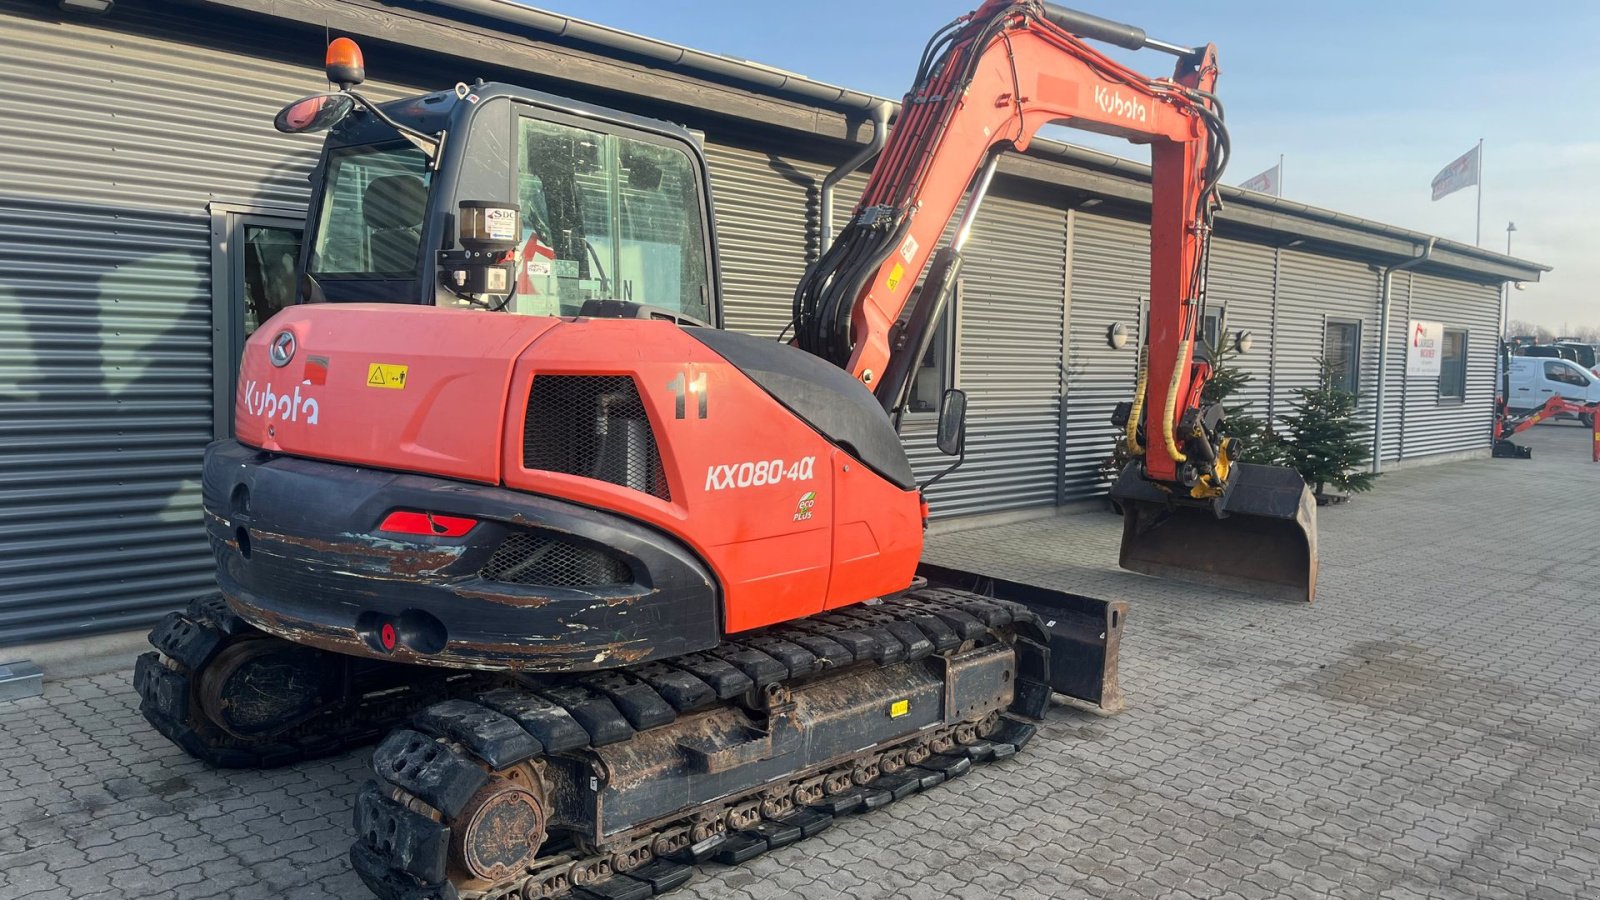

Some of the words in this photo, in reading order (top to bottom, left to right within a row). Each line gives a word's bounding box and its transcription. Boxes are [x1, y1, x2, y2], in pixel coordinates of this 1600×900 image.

[1094, 84, 1146, 122] Kubota
[244, 380, 319, 425] Kubota
[666, 371, 708, 420] 11
[792, 511, 813, 522] PLUS
